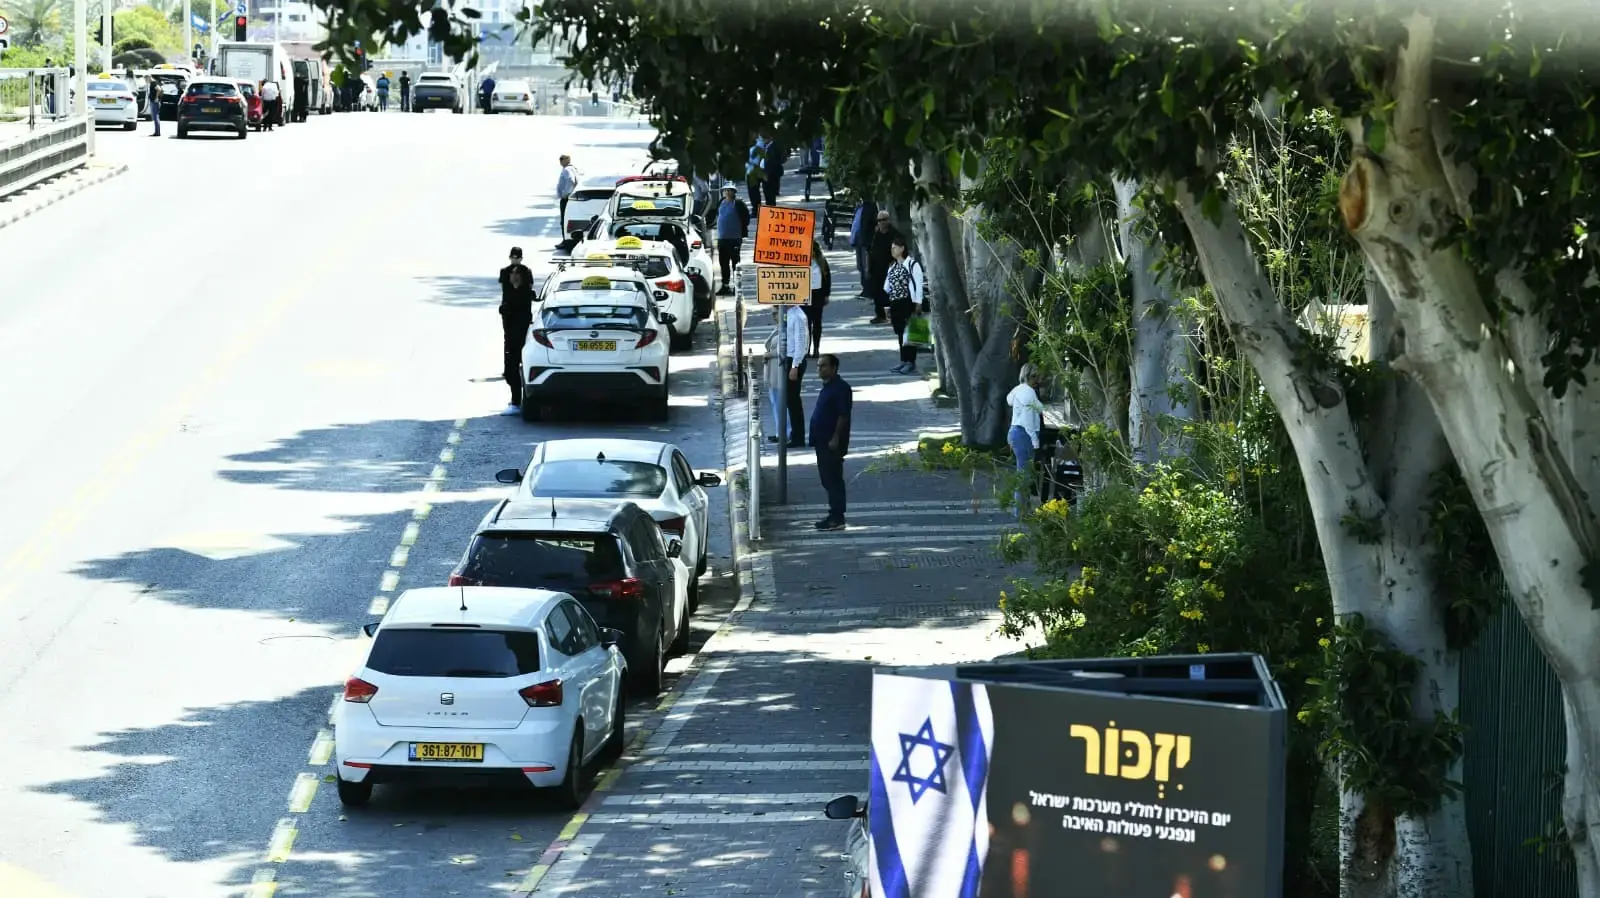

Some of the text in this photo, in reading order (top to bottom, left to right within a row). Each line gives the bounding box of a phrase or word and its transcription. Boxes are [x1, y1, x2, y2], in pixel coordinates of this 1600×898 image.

[770, 209, 807, 222] הולך רגל
[775, 223, 786, 233] לב
[790, 225, 806, 235] שים
[769, 237, 802, 248] משאיות
[757, 250, 808, 263] חוצות לפניך
[761, 271, 806, 279] זהירות רכב
[768, 282, 799, 290] עבודה
[771, 293, 796, 301] חוצה
[1029, 790, 1231, 827] יום הזיכרון לחללי מערכות ישראל
[1062, 815, 1196, 843] ונפגעי פעולות האיבה
